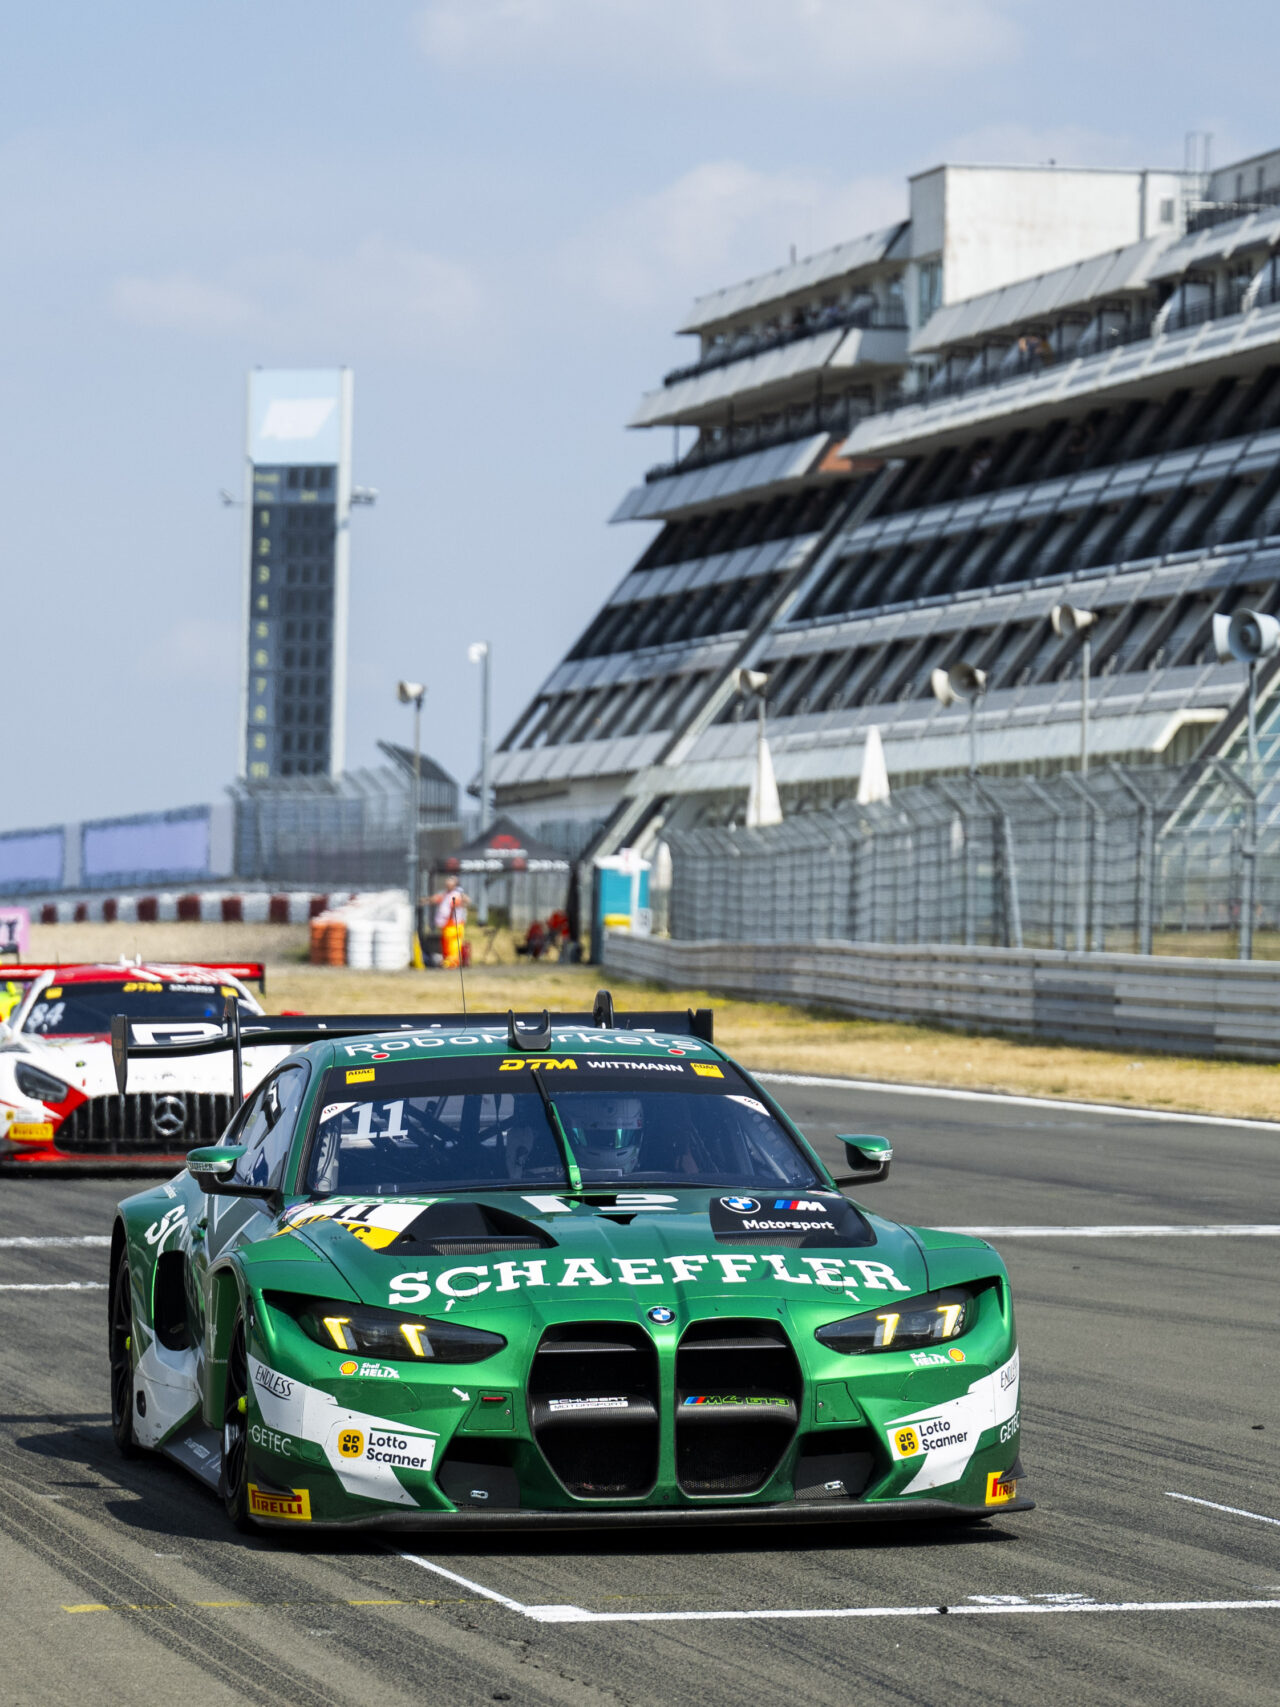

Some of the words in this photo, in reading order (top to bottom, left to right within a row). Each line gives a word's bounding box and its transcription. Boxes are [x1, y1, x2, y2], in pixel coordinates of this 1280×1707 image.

[343, 1032, 703, 1057] RoboMrkets
[498, 1058, 578, 1071] DTM
[587, 1060, 684, 1073] WITTMANN
[341, 1100, 409, 1140] 11
[742, 1220, 835, 1231] Motorsport
[388, 1254, 911, 1304] SCHAEFFLER
[255, 1365, 295, 1397] ENDLESS
[359, 1366, 400, 1378] HELIX
[705, 1395, 743, 1405] M4
[746, 1397, 790, 1407] GT3
[919, 1420, 951, 1437] Lotto
[251, 1424, 292, 1456] GETEC
[368, 1433, 407, 1450] Lotto
[922, 1431, 968, 1451] Scanner
[366, 1448, 426, 1468] Scanner
[251, 1489, 303, 1515] PIRELLI
